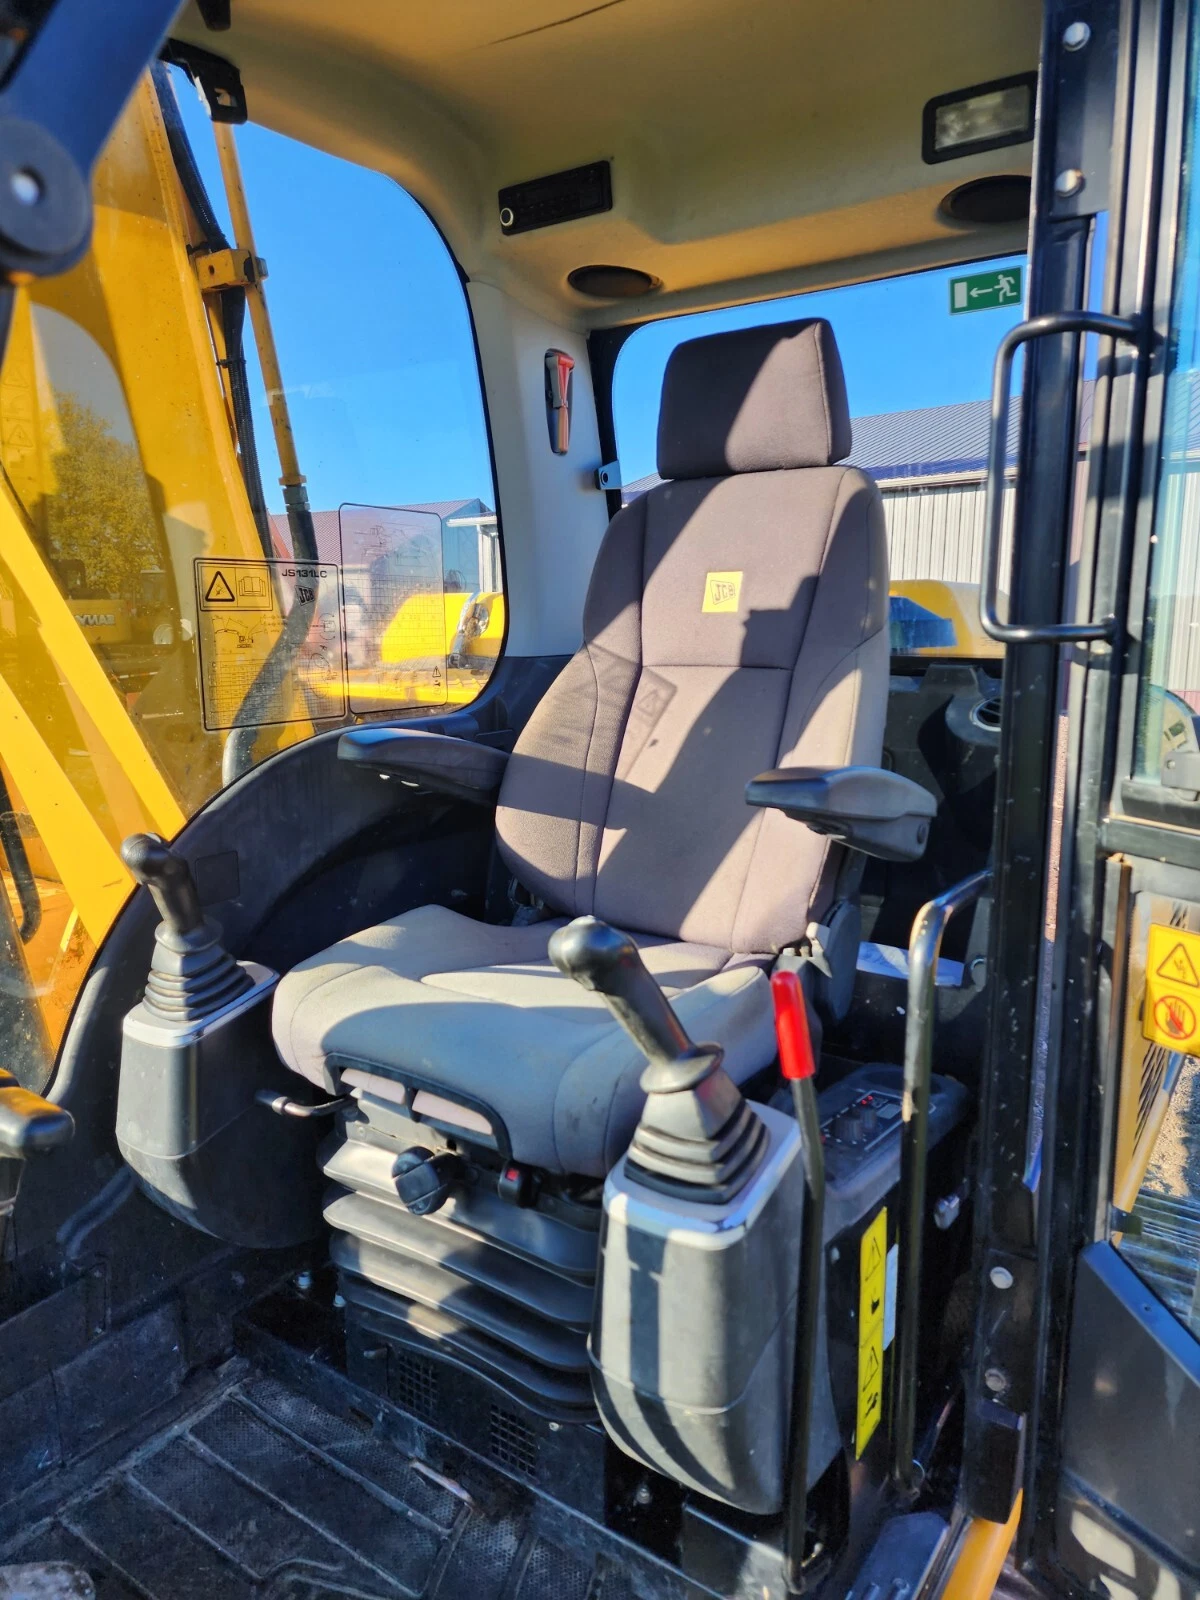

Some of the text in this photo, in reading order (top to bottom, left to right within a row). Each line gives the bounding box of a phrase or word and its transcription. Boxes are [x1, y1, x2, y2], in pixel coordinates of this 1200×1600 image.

[282, 569, 327, 578] JS131LC
[298, 586, 315, 603] JCB
[713, 582, 735, 602] JCB
